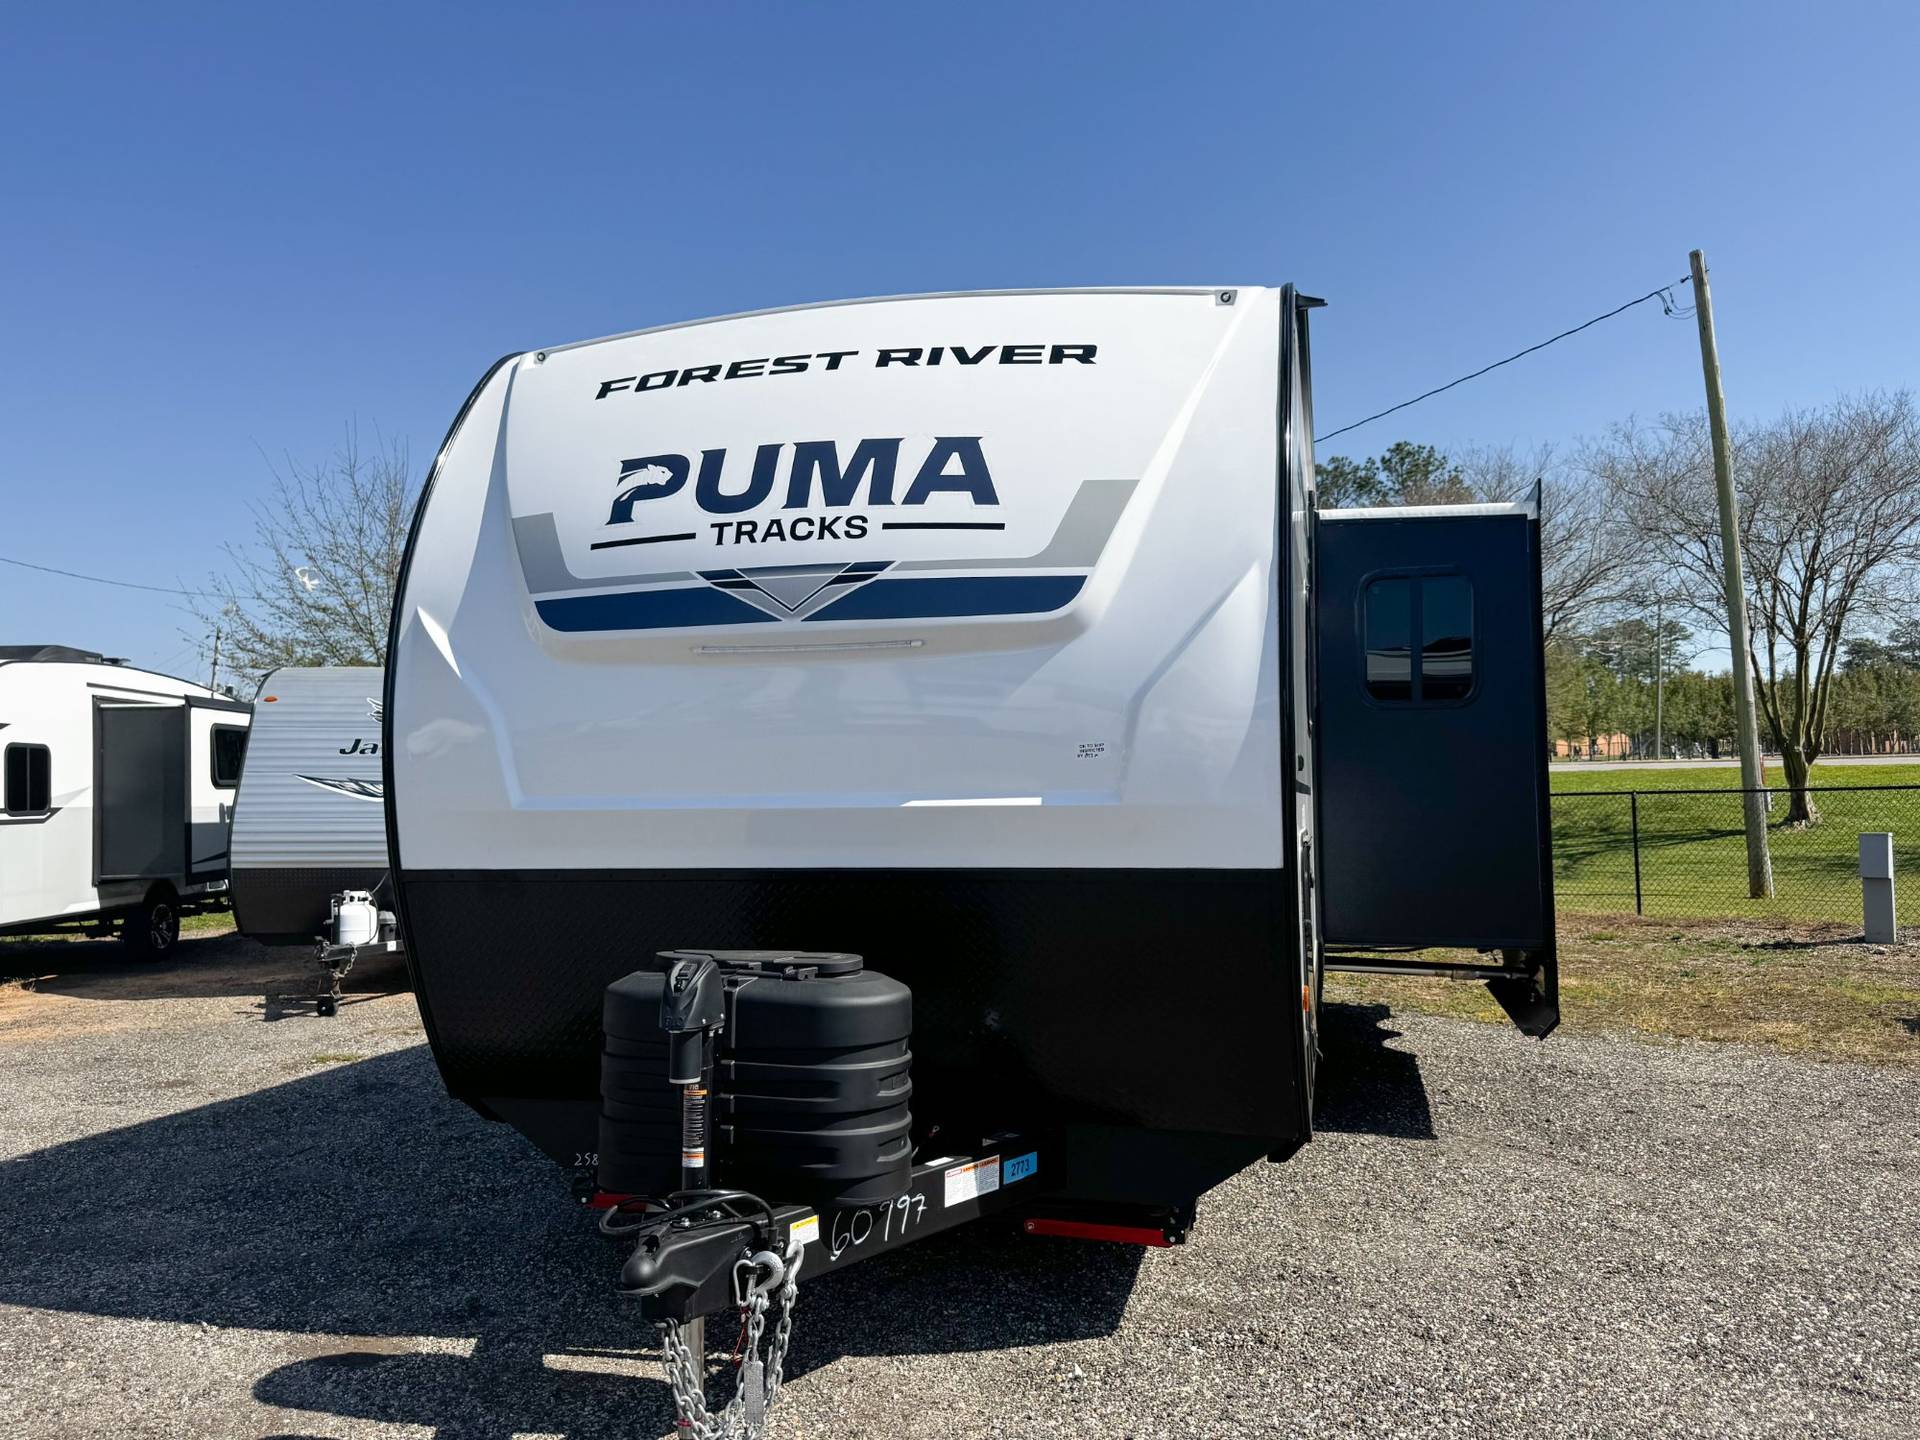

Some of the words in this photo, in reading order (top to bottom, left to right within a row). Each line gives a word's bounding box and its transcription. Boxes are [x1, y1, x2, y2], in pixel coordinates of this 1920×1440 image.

[595, 351, 859, 400] FOREST
[876, 344, 1098, 368] RIVER
[606, 436, 1000, 525] PUMA
[710, 515, 868, 546] TRACKS
[339, 738, 380, 755] Ja
[1010, 1158, 1031, 1178] 2773
